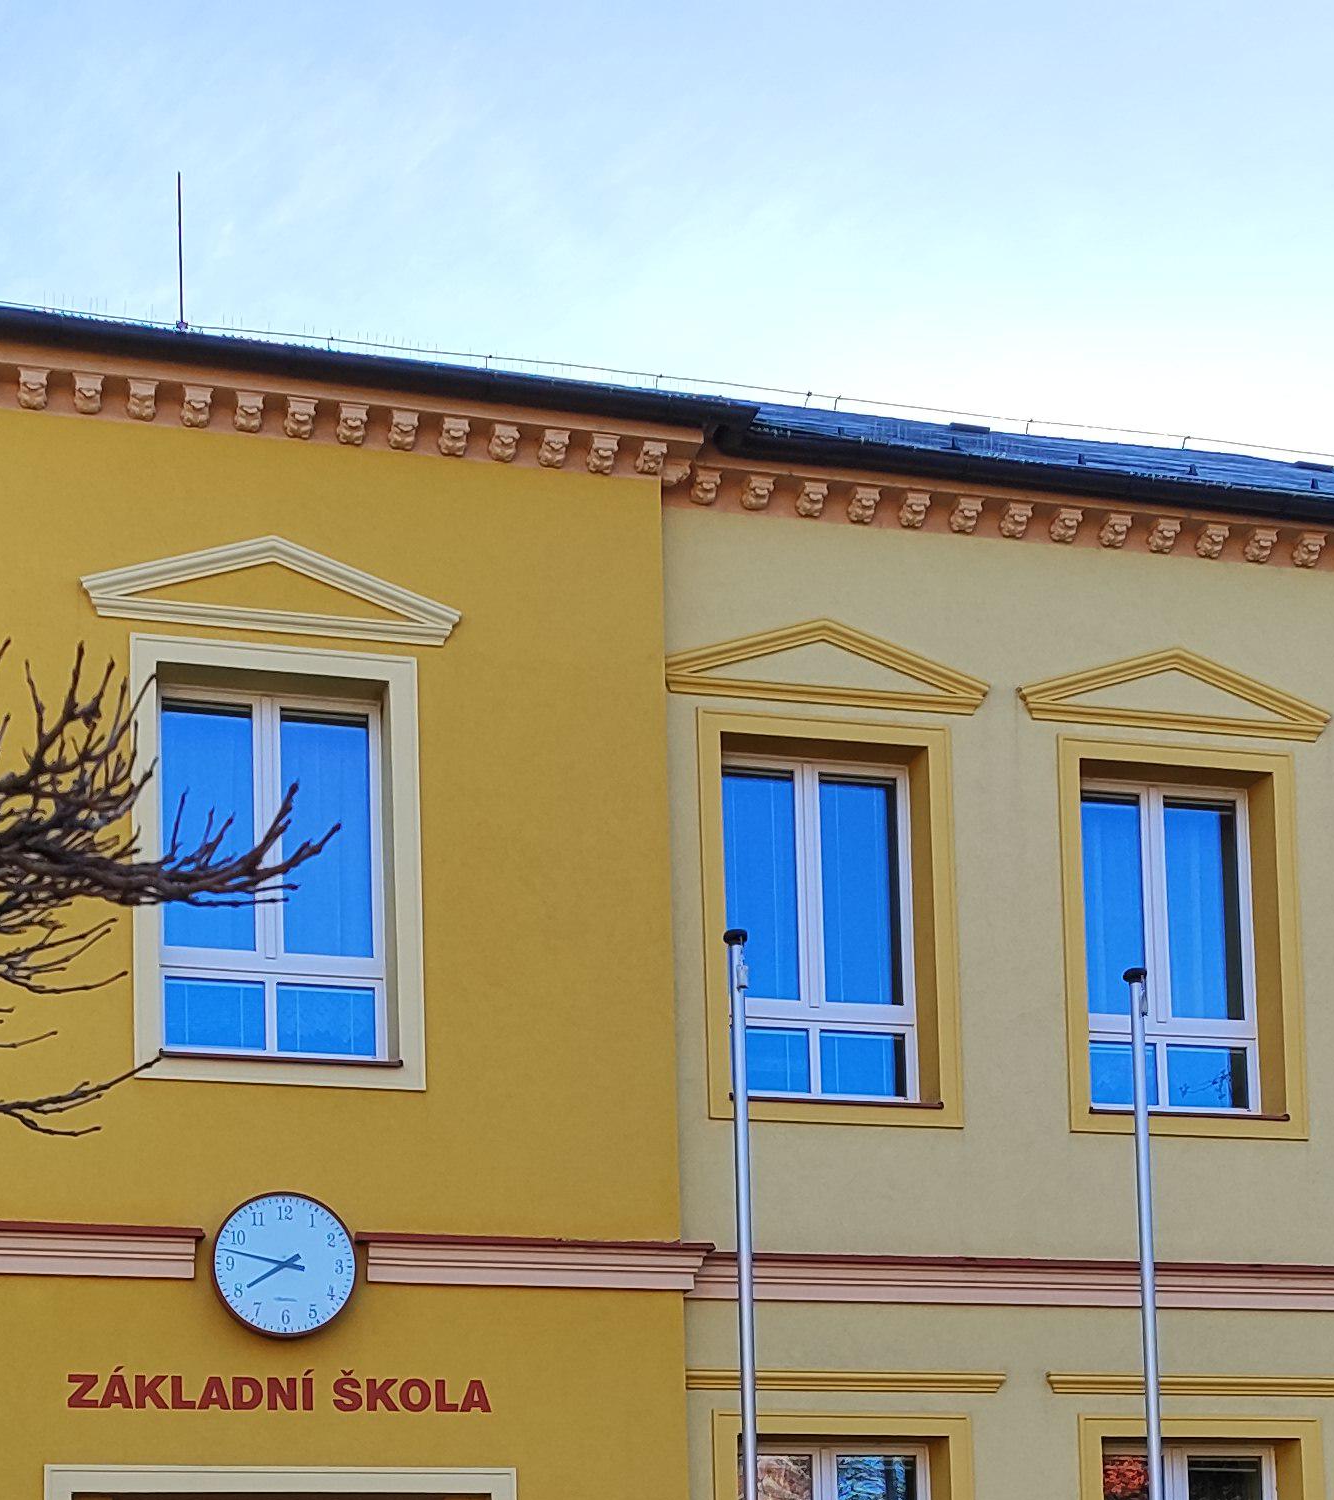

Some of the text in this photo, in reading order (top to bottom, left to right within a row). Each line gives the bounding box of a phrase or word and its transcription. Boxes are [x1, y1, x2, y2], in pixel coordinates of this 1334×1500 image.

[251, 1212, 265, 1226] 11
[277, 1205, 293, 1220] 12
[309, 1213, 315, 1228] 1
[230, 1230, 246, 1245] 10
[326, 1233, 336, 1248] 2
[226, 1256, 235, 1271] 9
[334, 1259, 344, 1274] 3
[234, 1283, 243, 1298] 8
[327, 1284, 336, 1300] 4
[253, 1302, 262, 1318] 7
[281, 1309, 291, 1324] 6
[308, 1304, 318, 1319] 5
[67, 1366, 493, 1413] ZÁKLADNÍ ŠKOLA
